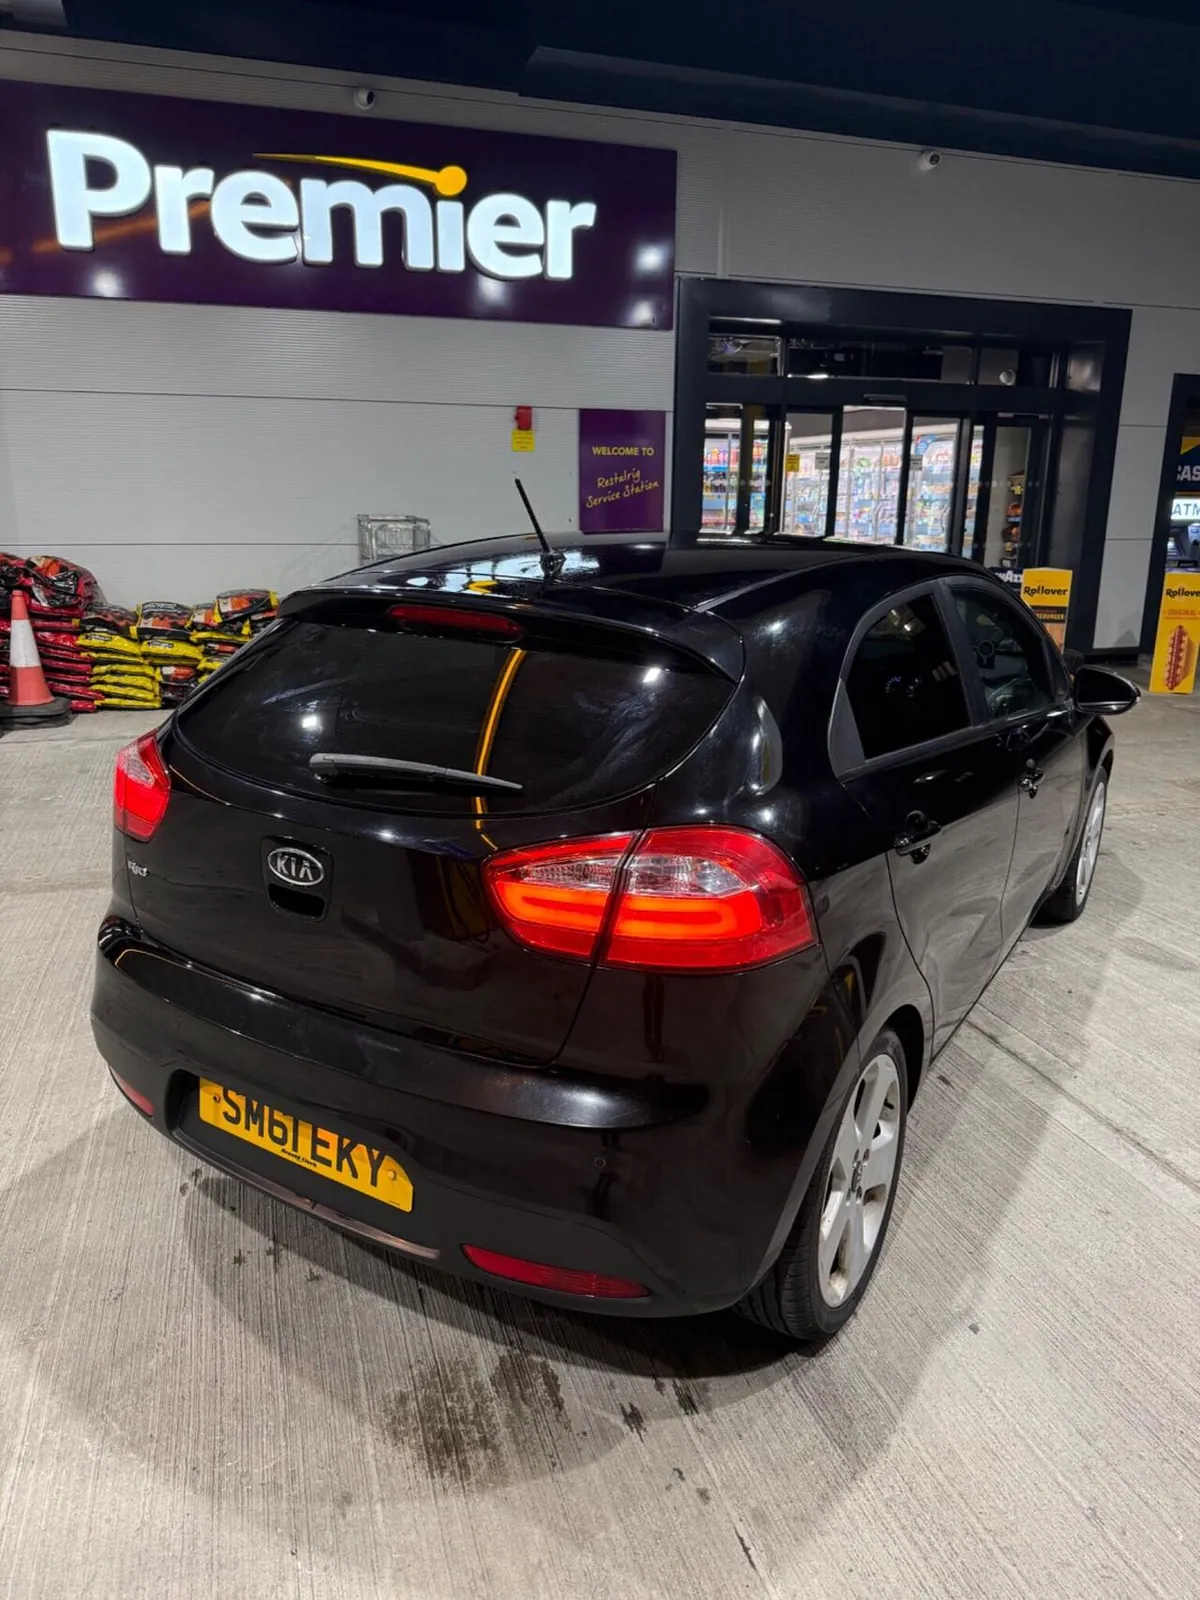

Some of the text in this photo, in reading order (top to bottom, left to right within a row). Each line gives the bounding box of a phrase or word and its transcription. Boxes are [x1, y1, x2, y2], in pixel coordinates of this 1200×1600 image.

[46, 129, 596, 280] Premier
[592, 446, 655, 456] WELCOME TO
[597, 467, 641, 488] Restalrig
[586, 480, 659, 508] Service Station
[1023, 584, 1068, 597] Rollover
[276, 853, 314, 881] KIA
